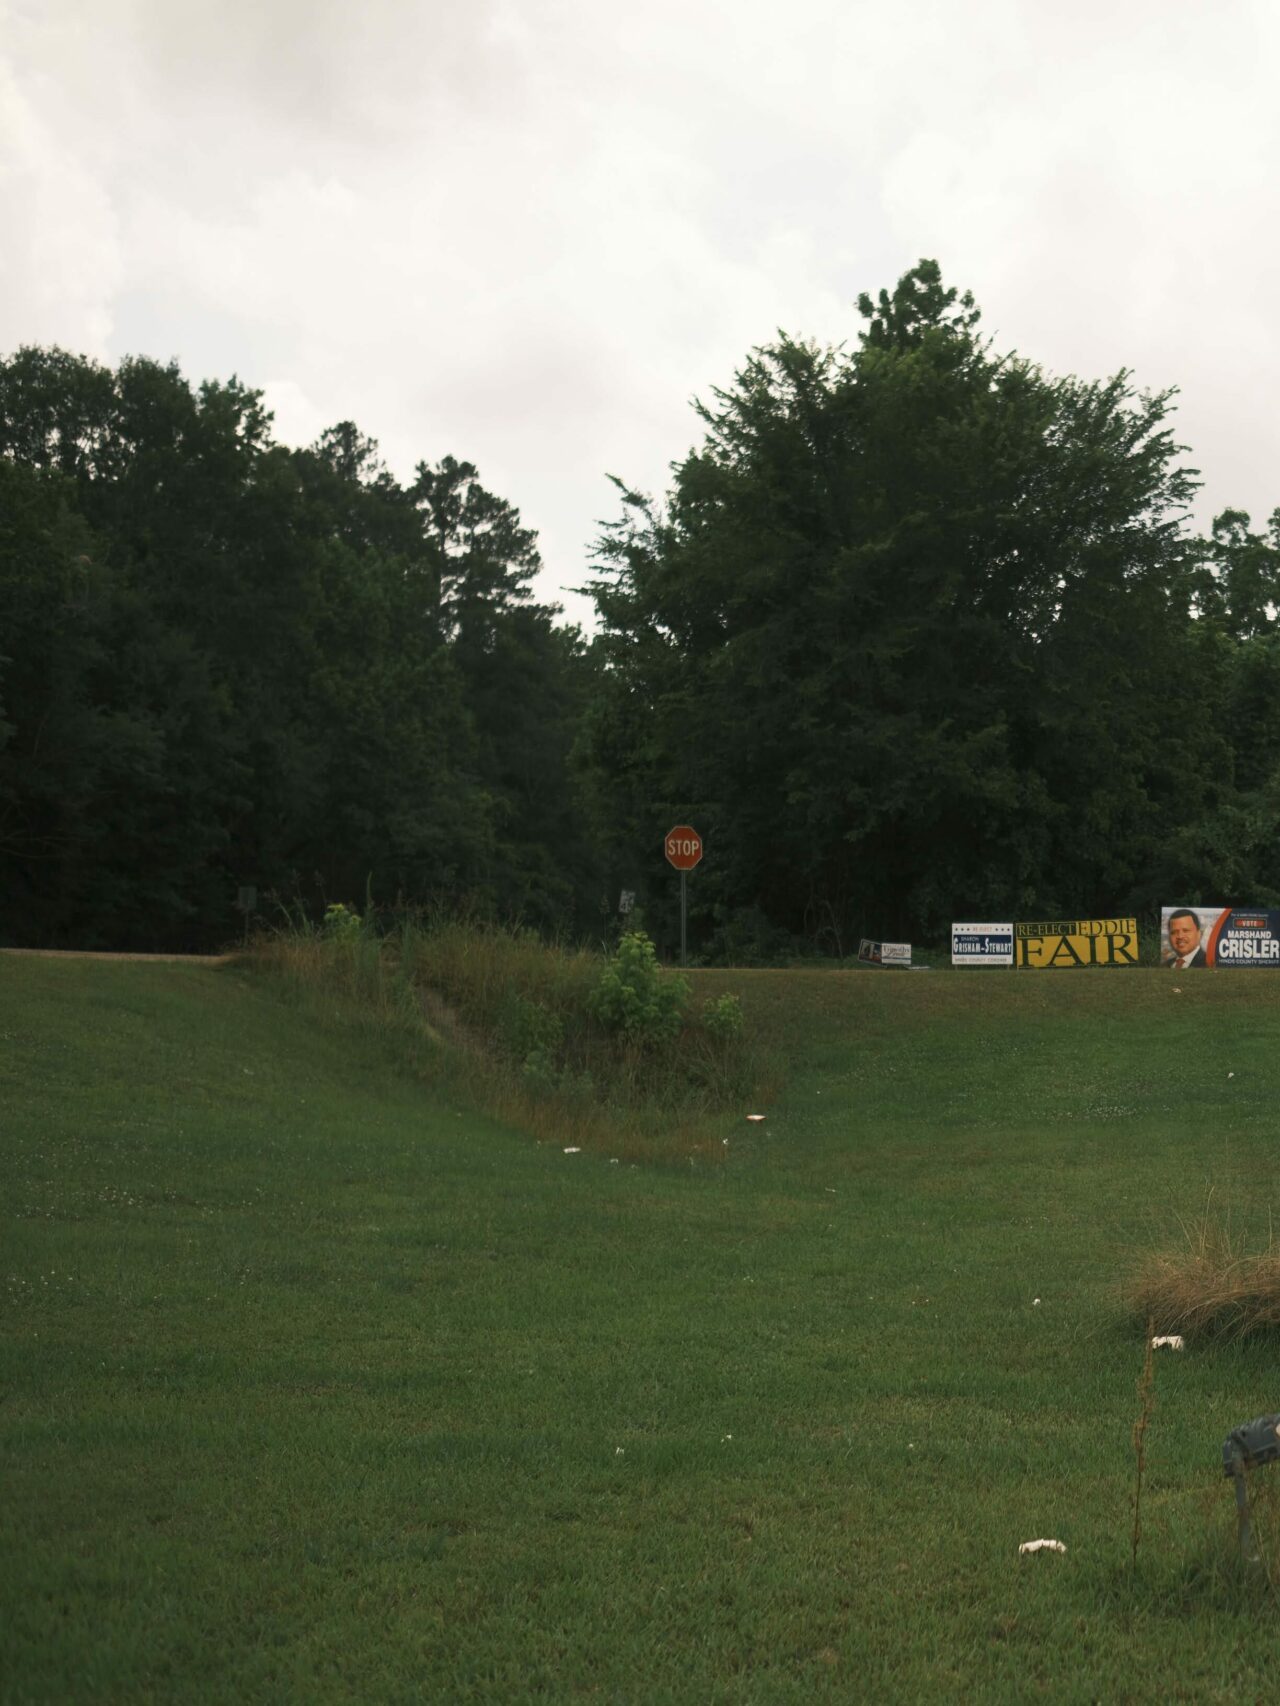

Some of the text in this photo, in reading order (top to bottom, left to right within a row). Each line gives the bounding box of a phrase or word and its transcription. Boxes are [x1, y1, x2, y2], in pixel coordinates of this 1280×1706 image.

[668, 840, 700, 856] STOP
[1019, 919, 1136, 936] RE-ELECT EDDIE
[1228, 930, 1271, 939] MARSHAND
[1018, 934, 1137, 967] FAIR
[1219, 939, 1280, 958] CRISLER
